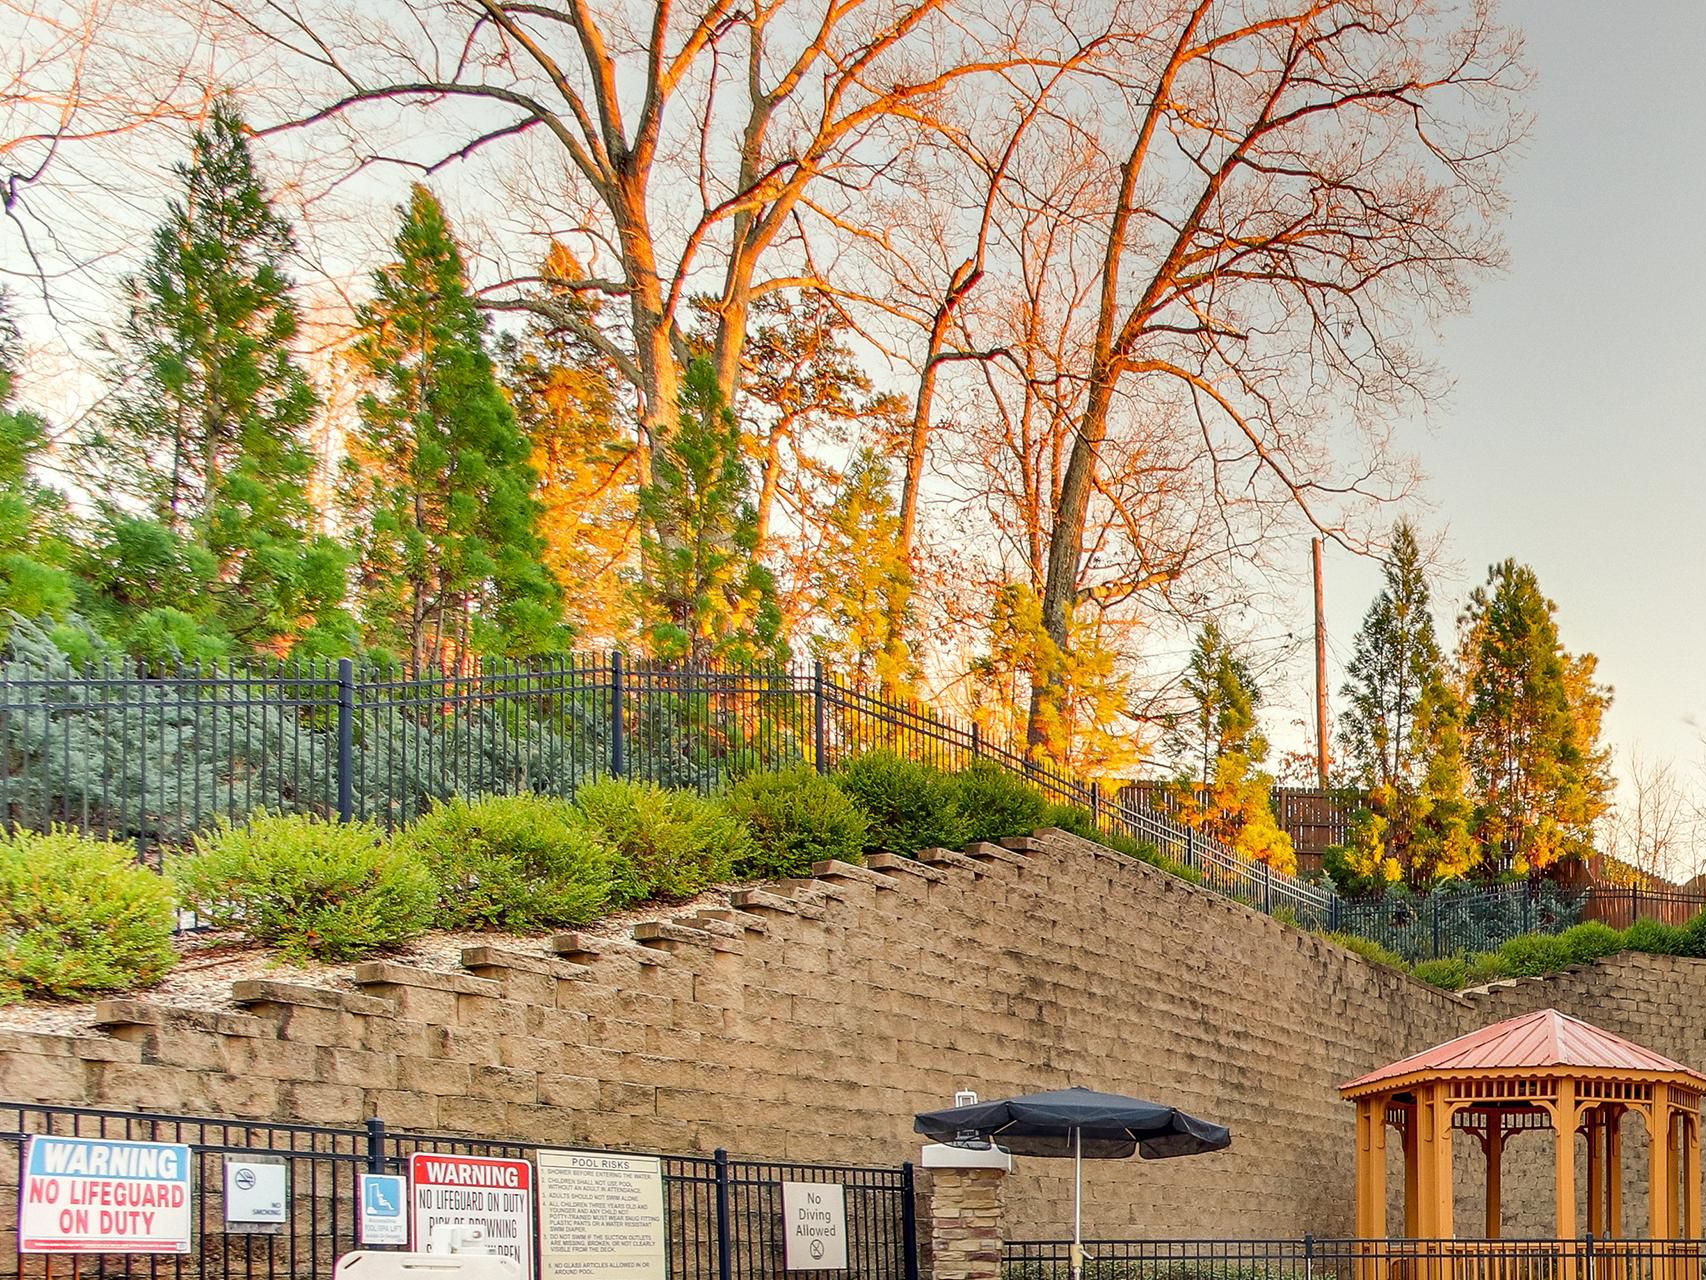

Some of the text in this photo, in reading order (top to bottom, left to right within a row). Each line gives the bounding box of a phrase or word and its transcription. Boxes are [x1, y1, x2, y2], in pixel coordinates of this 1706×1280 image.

[44, 1142, 178, 1179] WARNING
[572, 1158, 630, 1170] POOL RISKS
[426, 1161, 520, 1187] WARNING
[29, 1177, 185, 1208] NO LIFEGUARD
[419, 1189, 525, 1213] NO LIFEGUARD ON DUTY
[807, 1192, 821, 1204] No
[59, 1208, 155, 1235] ON DUTY
[799, 1208, 831, 1223] Diving
[796, 1225, 836, 1236] Allowed
